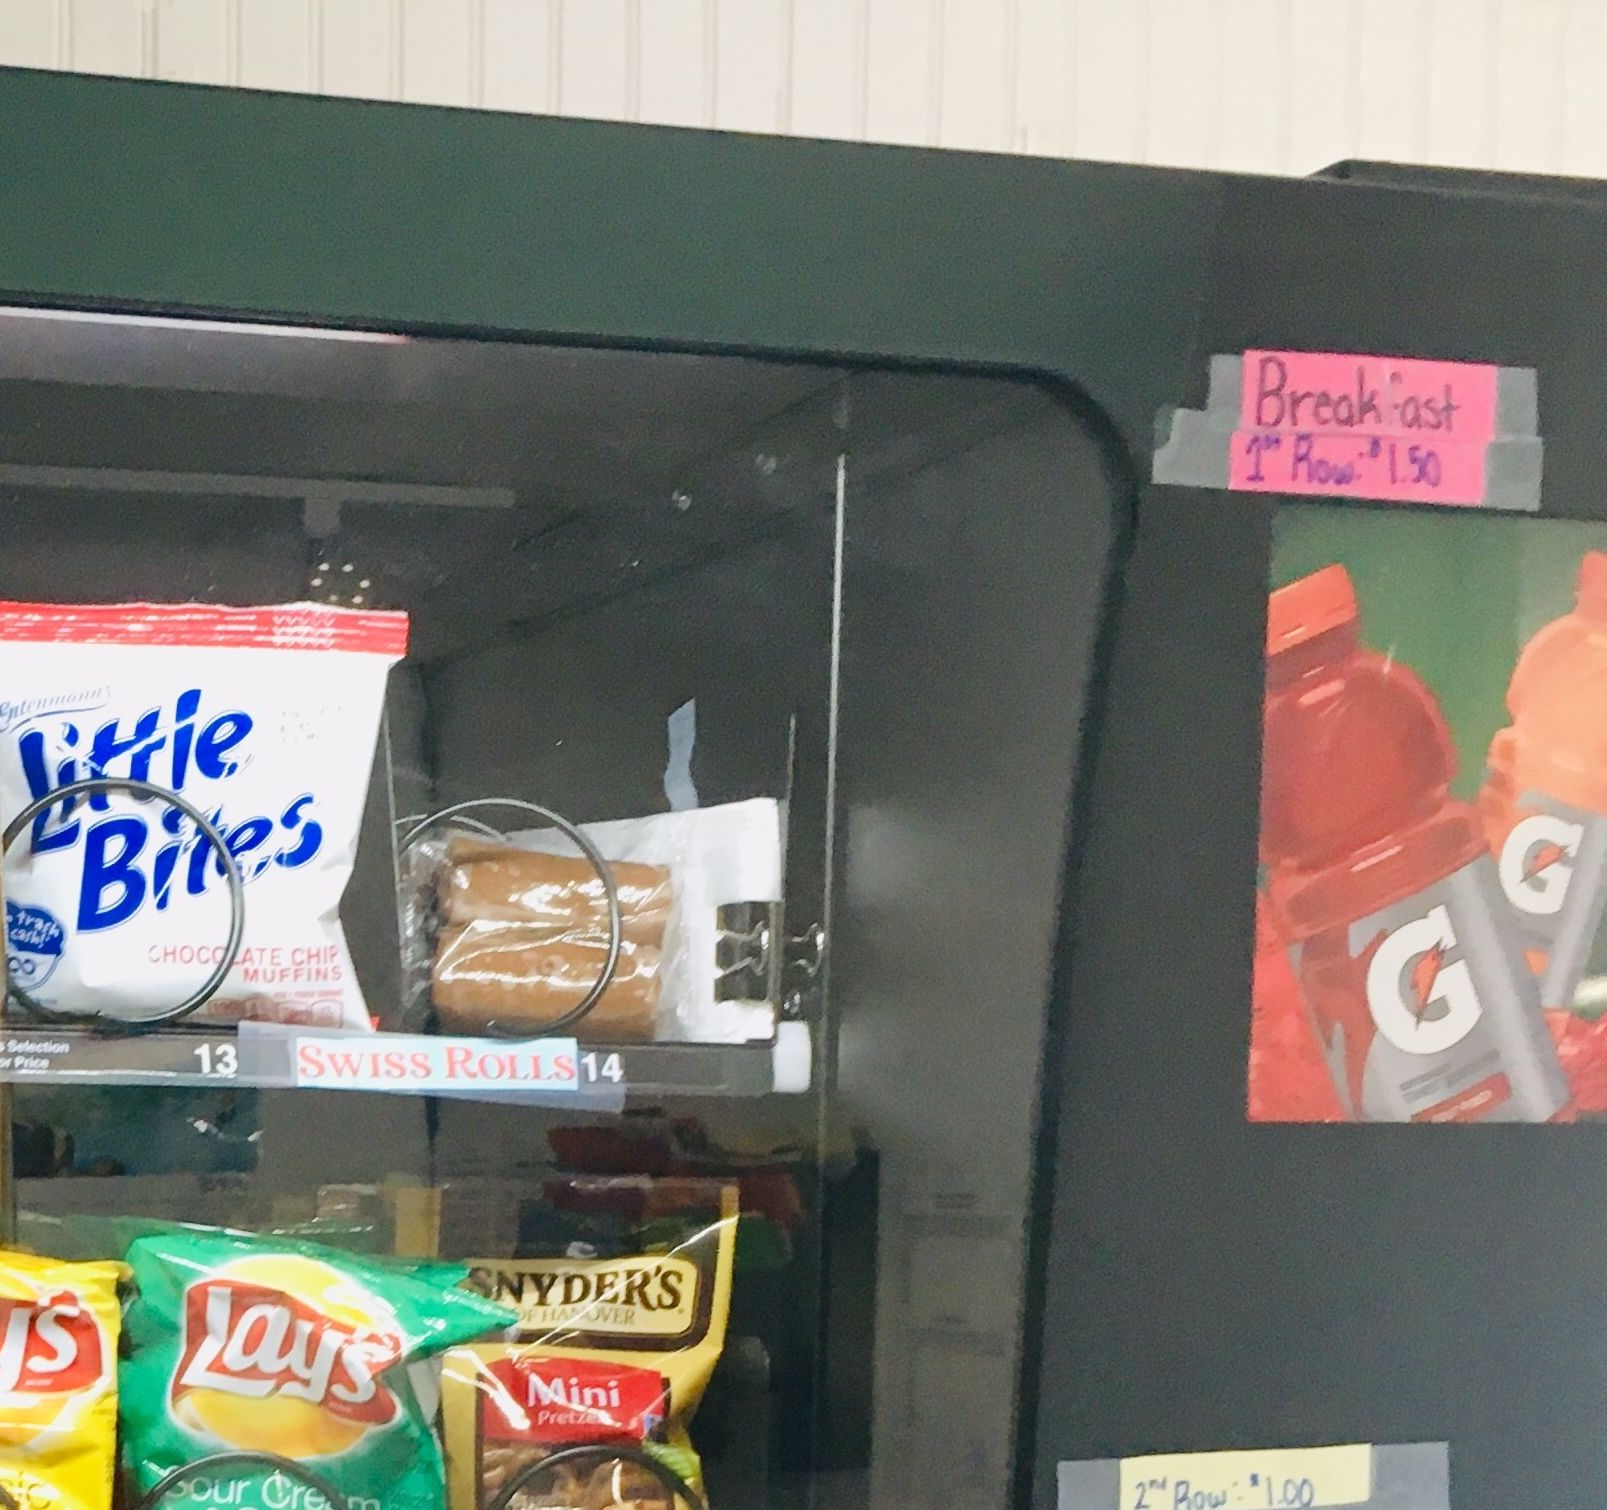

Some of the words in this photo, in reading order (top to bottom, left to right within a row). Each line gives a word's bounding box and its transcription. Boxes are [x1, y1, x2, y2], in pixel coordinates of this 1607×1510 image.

[17, 688, 254, 856] Little
[75, 792, 324, 934] Bites
[1498, 814, 1585, 915] G
[242, 965, 343, 984] MUFFINS
[290, 946, 340, 968] CHIP
[1366, 904, 1484, 1055] G
[7, 1039, 70, 1054] Selection
[13, 1055, 50, 1069] Price
[192, 1043, 239, 1075] 13
[298, 1044, 432, 1082] SWISS
[443, 1046, 578, 1083] ROLLS
[581, 1053, 624, 1083] 14
[468, 1264, 684, 1312] SNYDER'S
[180, 1286, 398, 1402] Lay's
[527, 1372, 621, 1408] Mini
[537, 1409, 614, 1427] Pretze
